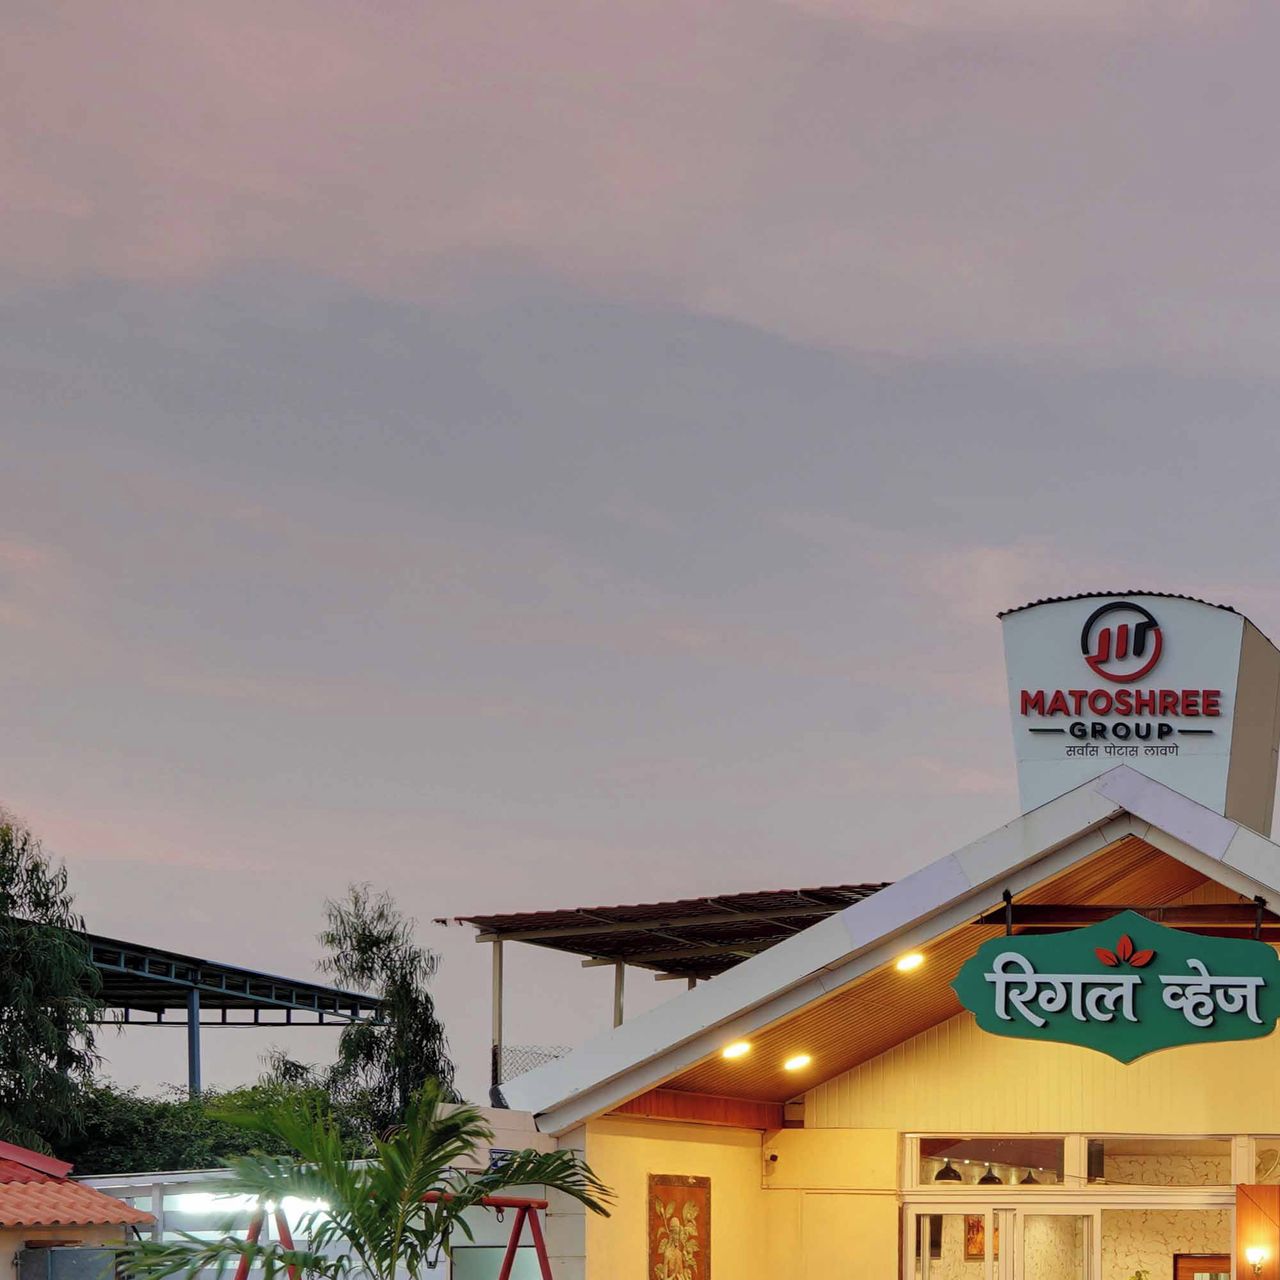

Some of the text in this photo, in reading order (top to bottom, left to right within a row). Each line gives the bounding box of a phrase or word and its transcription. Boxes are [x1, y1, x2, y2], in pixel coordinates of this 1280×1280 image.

[1020, 689, 1222, 717] MATOSHREE
[1069, 721, 1174, 740] GROUP
[984, 951, 1267, 1028] रिगल व्हेज
